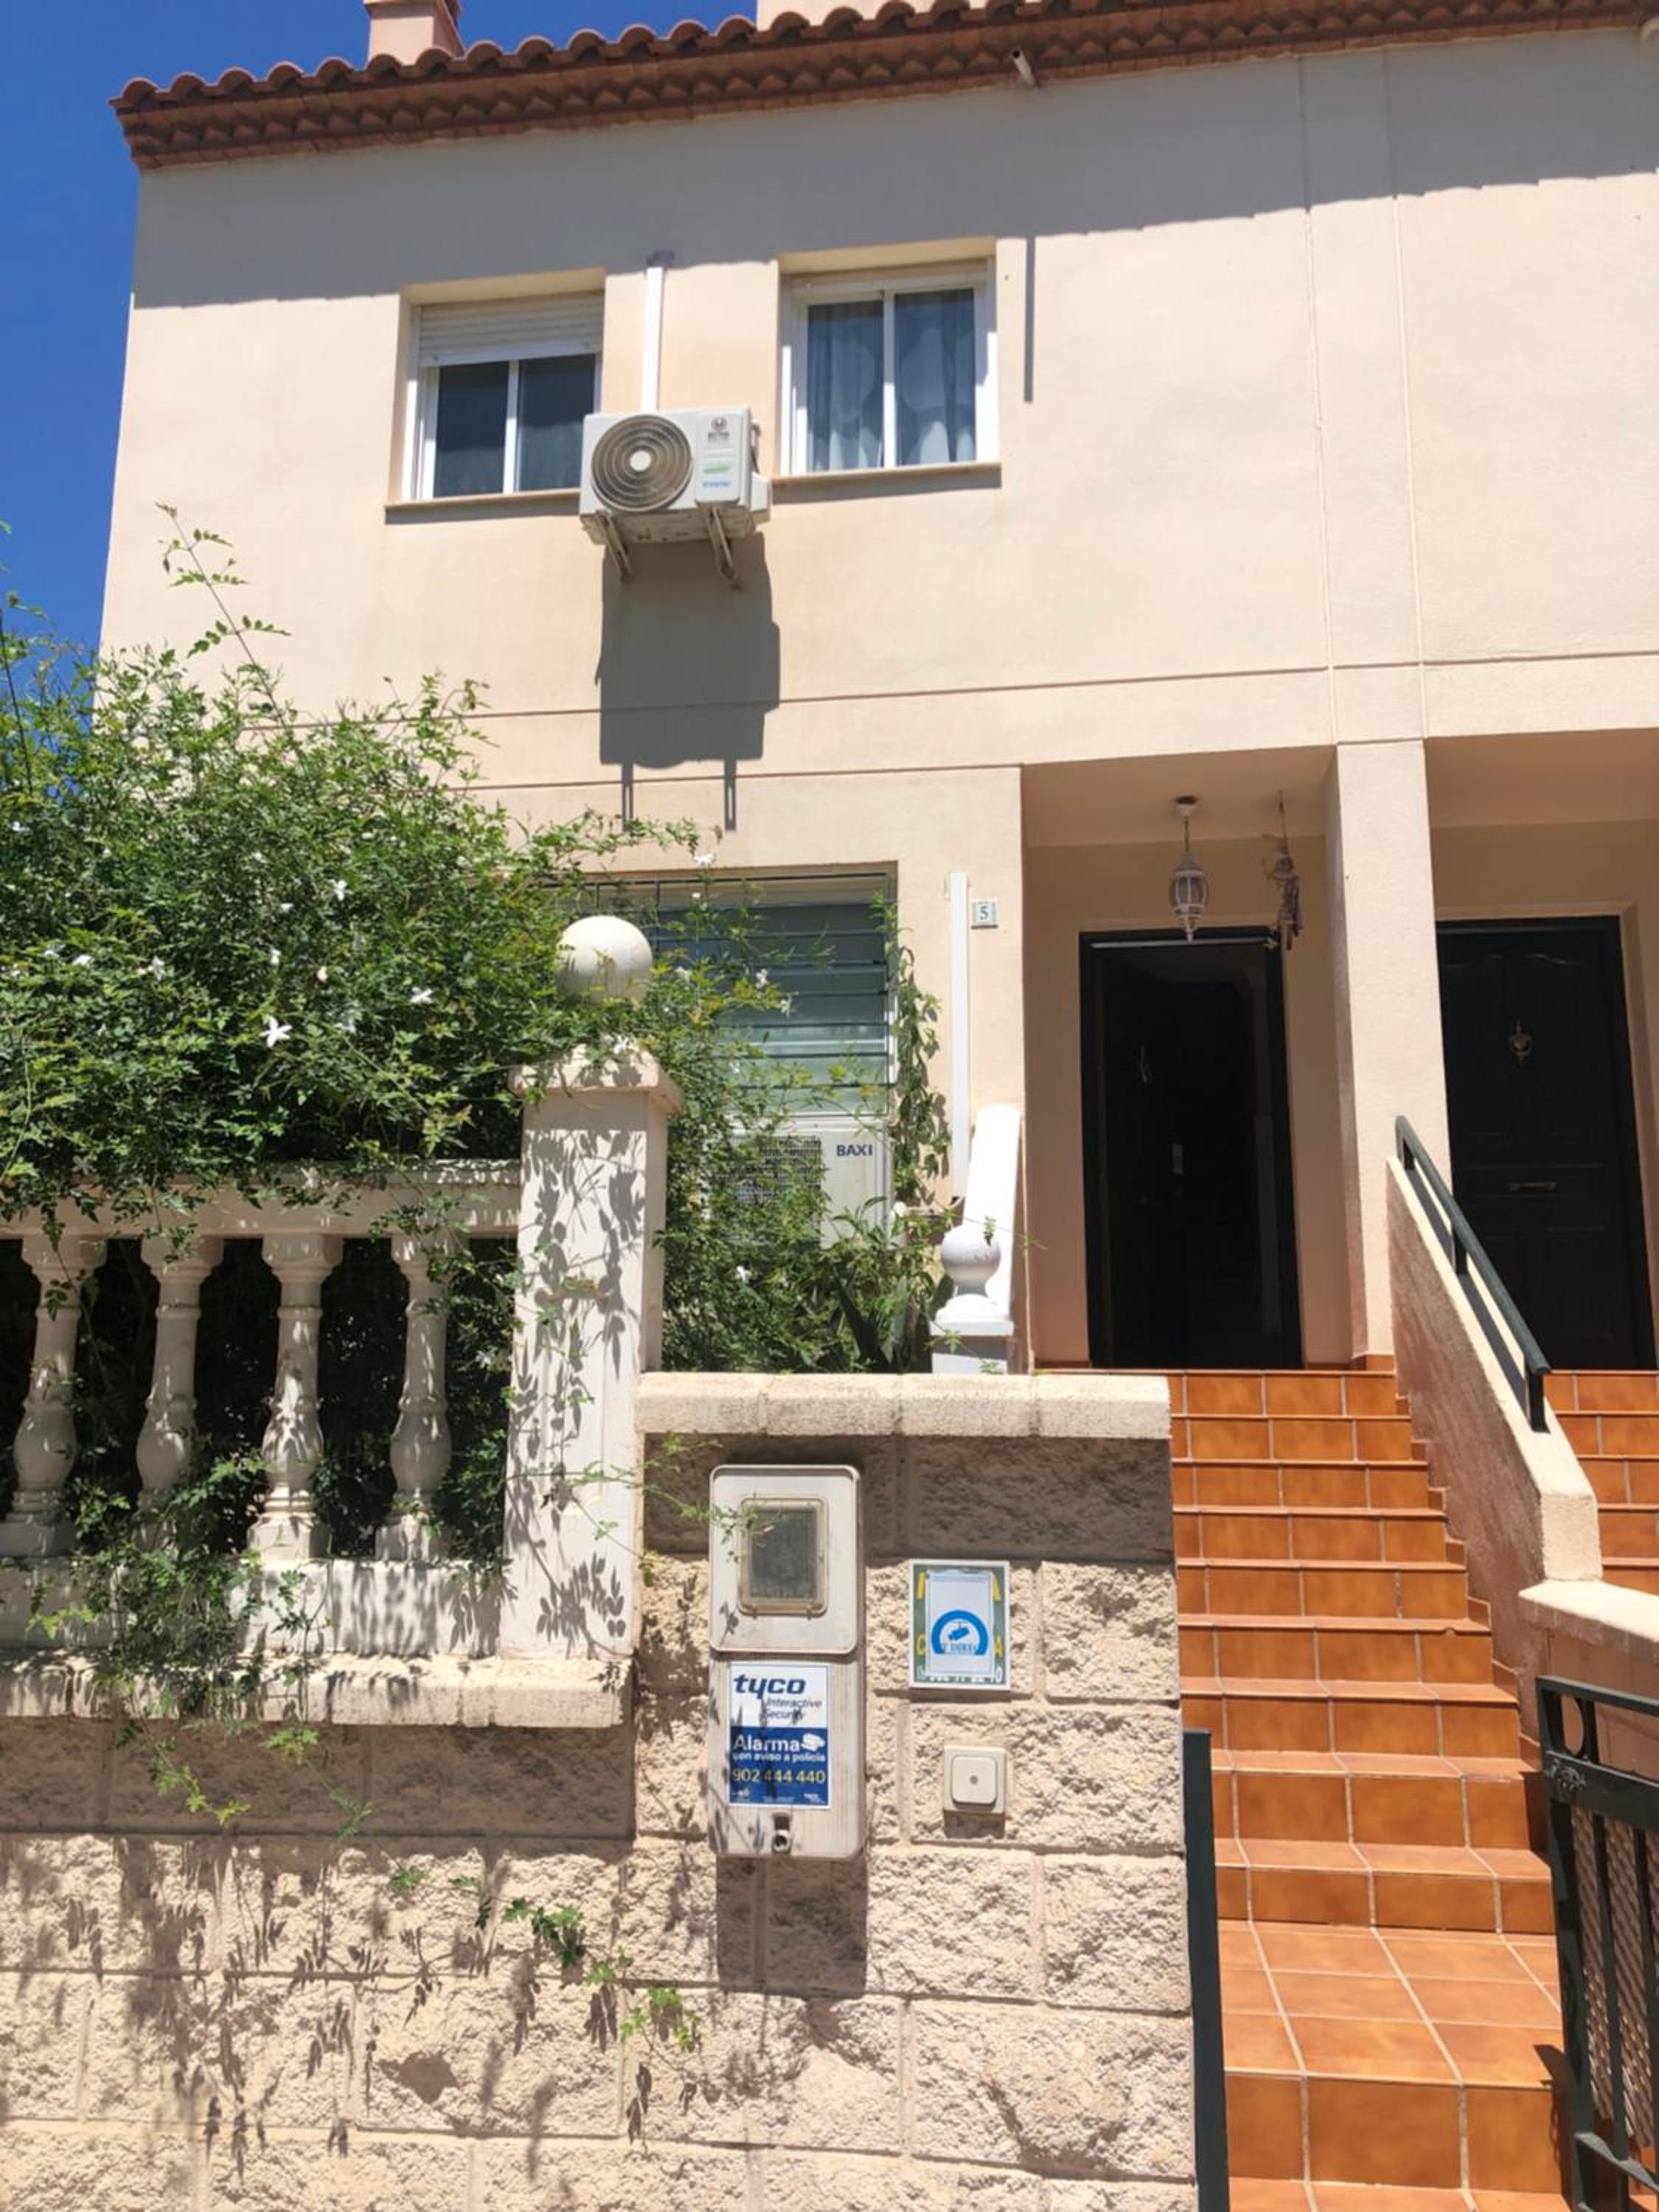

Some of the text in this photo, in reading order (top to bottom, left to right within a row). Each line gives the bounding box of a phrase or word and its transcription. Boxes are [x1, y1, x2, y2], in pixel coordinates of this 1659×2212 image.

[979, 905, 989, 920] 5
[836, 1144, 873, 1157] BAXI
[733, 1674, 807, 1700] tyco
[733, 1734, 800, 1752] Alarma
[732, 1753, 752, 1761] con
[754, 1753, 782, 1761] aviso
[783, 1753, 791, 1761] a
[732, 1768, 826, 1784] 902 444 440
